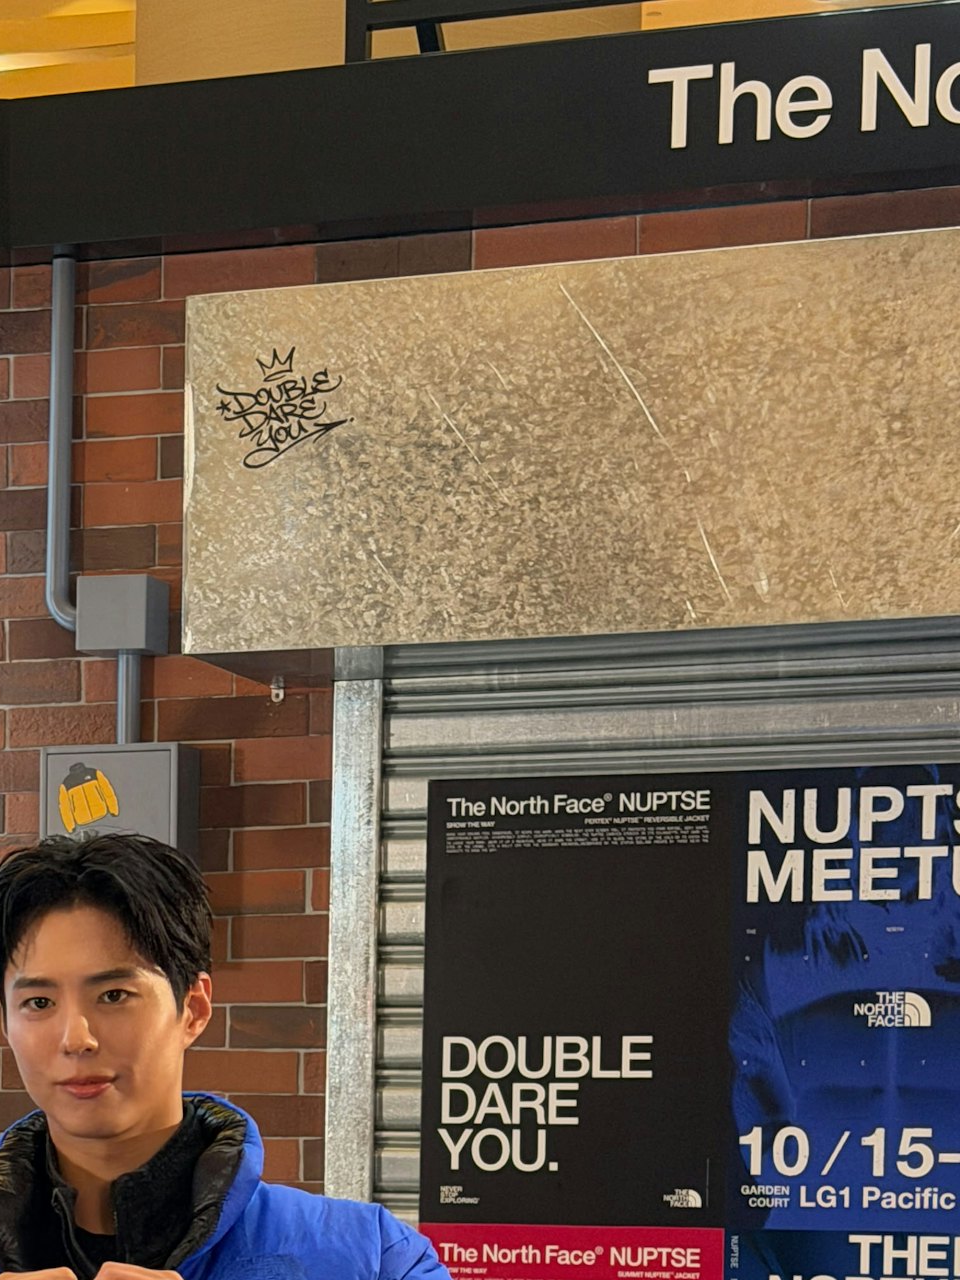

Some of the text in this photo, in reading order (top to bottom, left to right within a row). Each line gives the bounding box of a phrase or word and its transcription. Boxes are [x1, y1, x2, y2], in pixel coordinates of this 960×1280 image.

[647, 61, 834, 149] The
[216, 368, 343, 415] DOUBLE
[224, 397, 327, 438] DARE
[446, 797, 486, 817] The
[490, 795, 549, 816] North
[619, 790, 711, 812] NUPTSE
[748, 784, 960, 844] NUPT
[746, 845, 960, 903] MEET
[853, 1003, 904, 1016] NORTH
[876, 991, 904, 1003] THE
[867, 1015, 904, 1027] FACE
[442, 1035, 653, 1079] DOUBLE
[441, 1082, 579, 1125] DARE
[437, 1128, 559, 1172] YOU.
[662, 1194, 688, 1202] NORTH
[670, 1200, 688, 1208] FACE
[740, 1185, 790, 1196] GARDEN
[748, 1197, 790, 1208] COURT
[799, 1186, 957, 1210] LG1 Pacific
[439, 1243, 478, 1262] The
[482, 1243, 541, 1264] North
[610, 1246, 701, 1268] NUPTSE
[730, 1235, 739, 1269] NUPTSE
[848, 1235, 950, 1277] THE
